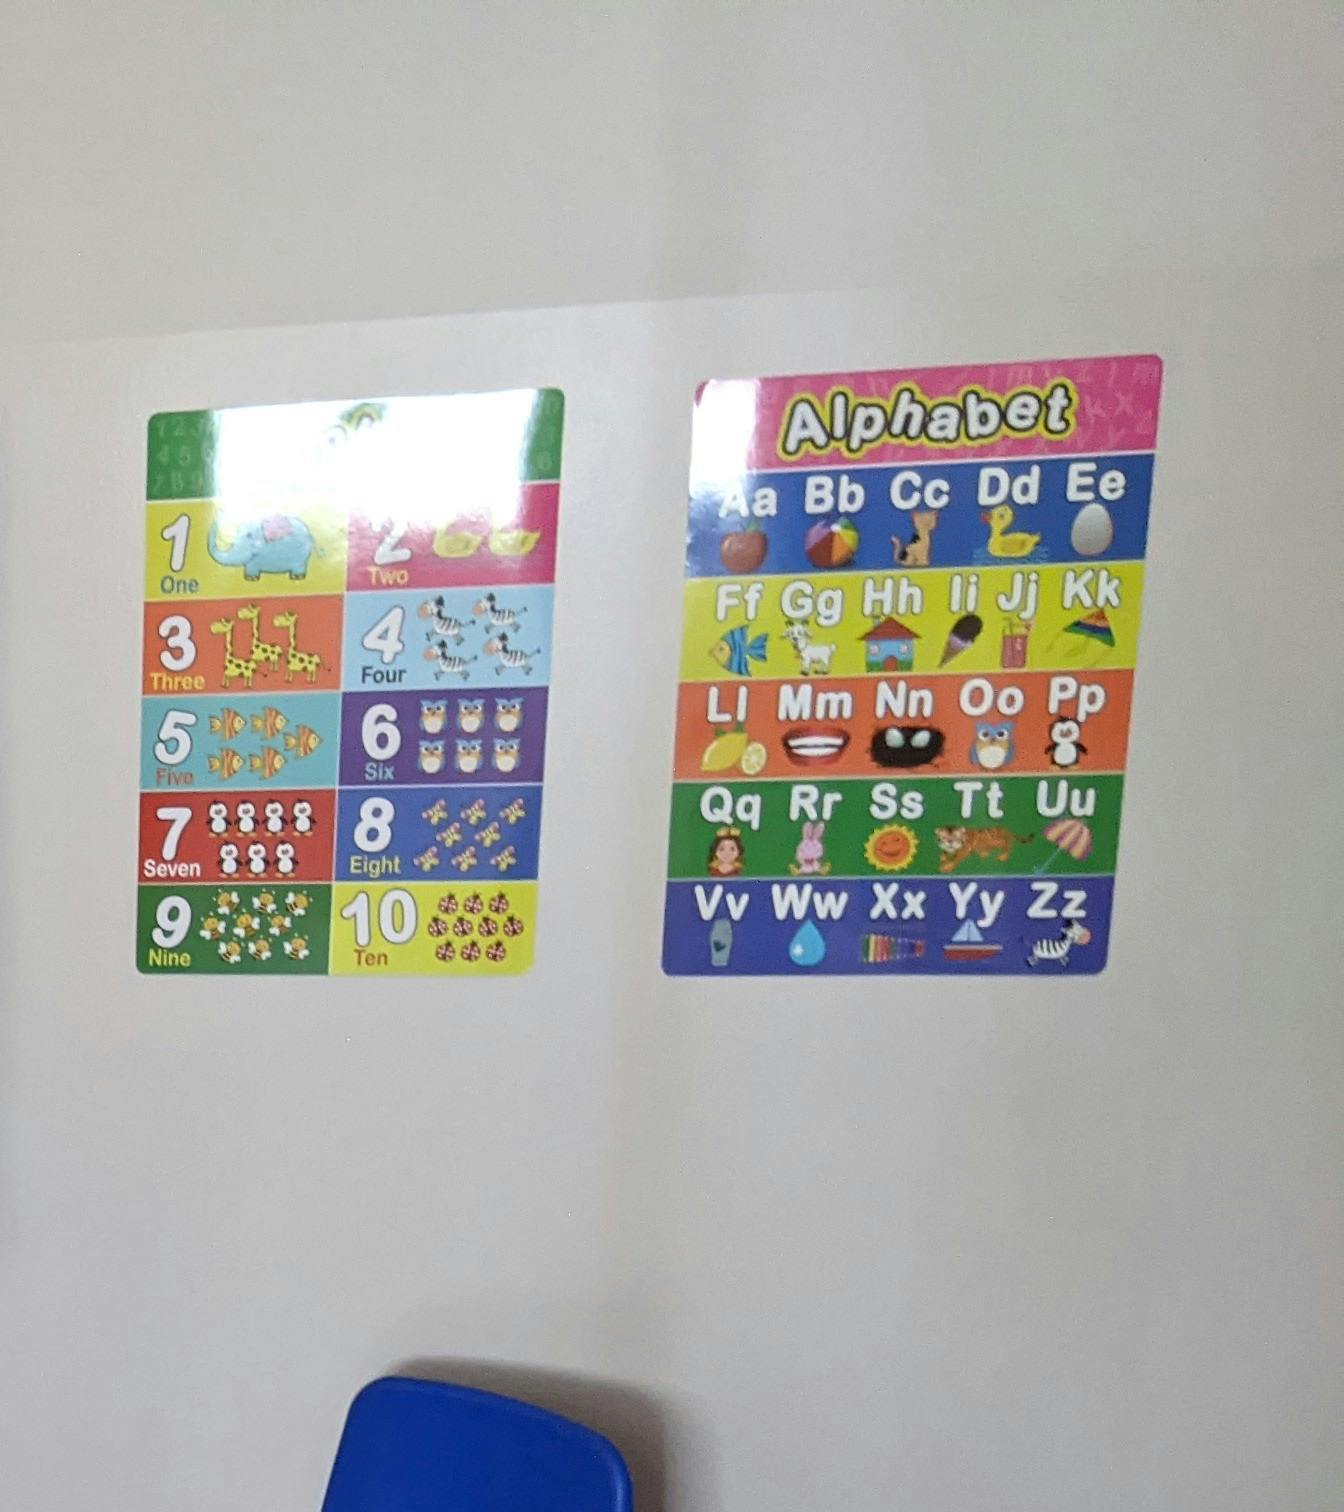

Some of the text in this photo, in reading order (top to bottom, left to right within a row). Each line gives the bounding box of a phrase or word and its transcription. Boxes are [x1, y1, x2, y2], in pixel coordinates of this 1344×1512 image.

[781, 381, 1074, 454] Alphabet
[804, 473, 865, 514] Bb
[890, 471, 950, 510] Cc
[977, 465, 1040, 505] Dd
[1066, 463, 1126, 501] Ee
[161, 513, 191, 572] 1
[160, 576, 199, 594] One
[368, 567, 408, 586] Two
[717, 581, 764, 622] Ff
[781, 580, 844, 627] Gg
[862, 577, 924, 617] Hh
[997, 571, 1039, 619] Jj
[1063, 569, 1121, 610] Kk
[158, 615, 196, 670] 3
[362, 606, 404, 664] 4
[150, 672, 205, 690] Three
[361, 666, 407, 684] Four
[777, 685, 852, 721] Mm
[875, 681, 934, 719] Nn
[959, 678, 1024, 716] Oo
[1048, 677, 1106, 722] Pp
[154, 709, 197, 765] 5
[362, 704, 401, 760] 6
[155, 768, 193, 785] Five
[365, 763, 394, 781] Six
[354, 797, 395, 852] 8
[699, 779, 1095, 830] Qq Rr Ss Tt Uu
[156, 807, 192, 861] 7
[144, 859, 201, 878] Seven
[350, 856, 401, 876] Eight
[152, 895, 191, 948] 9
[341, 888, 418, 947] 10
[694, 882, 1087, 927] Vv Ww Xx Yy Zz
[149, 948, 191, 967] Nine
[354, 949, 388, 966] Ten
